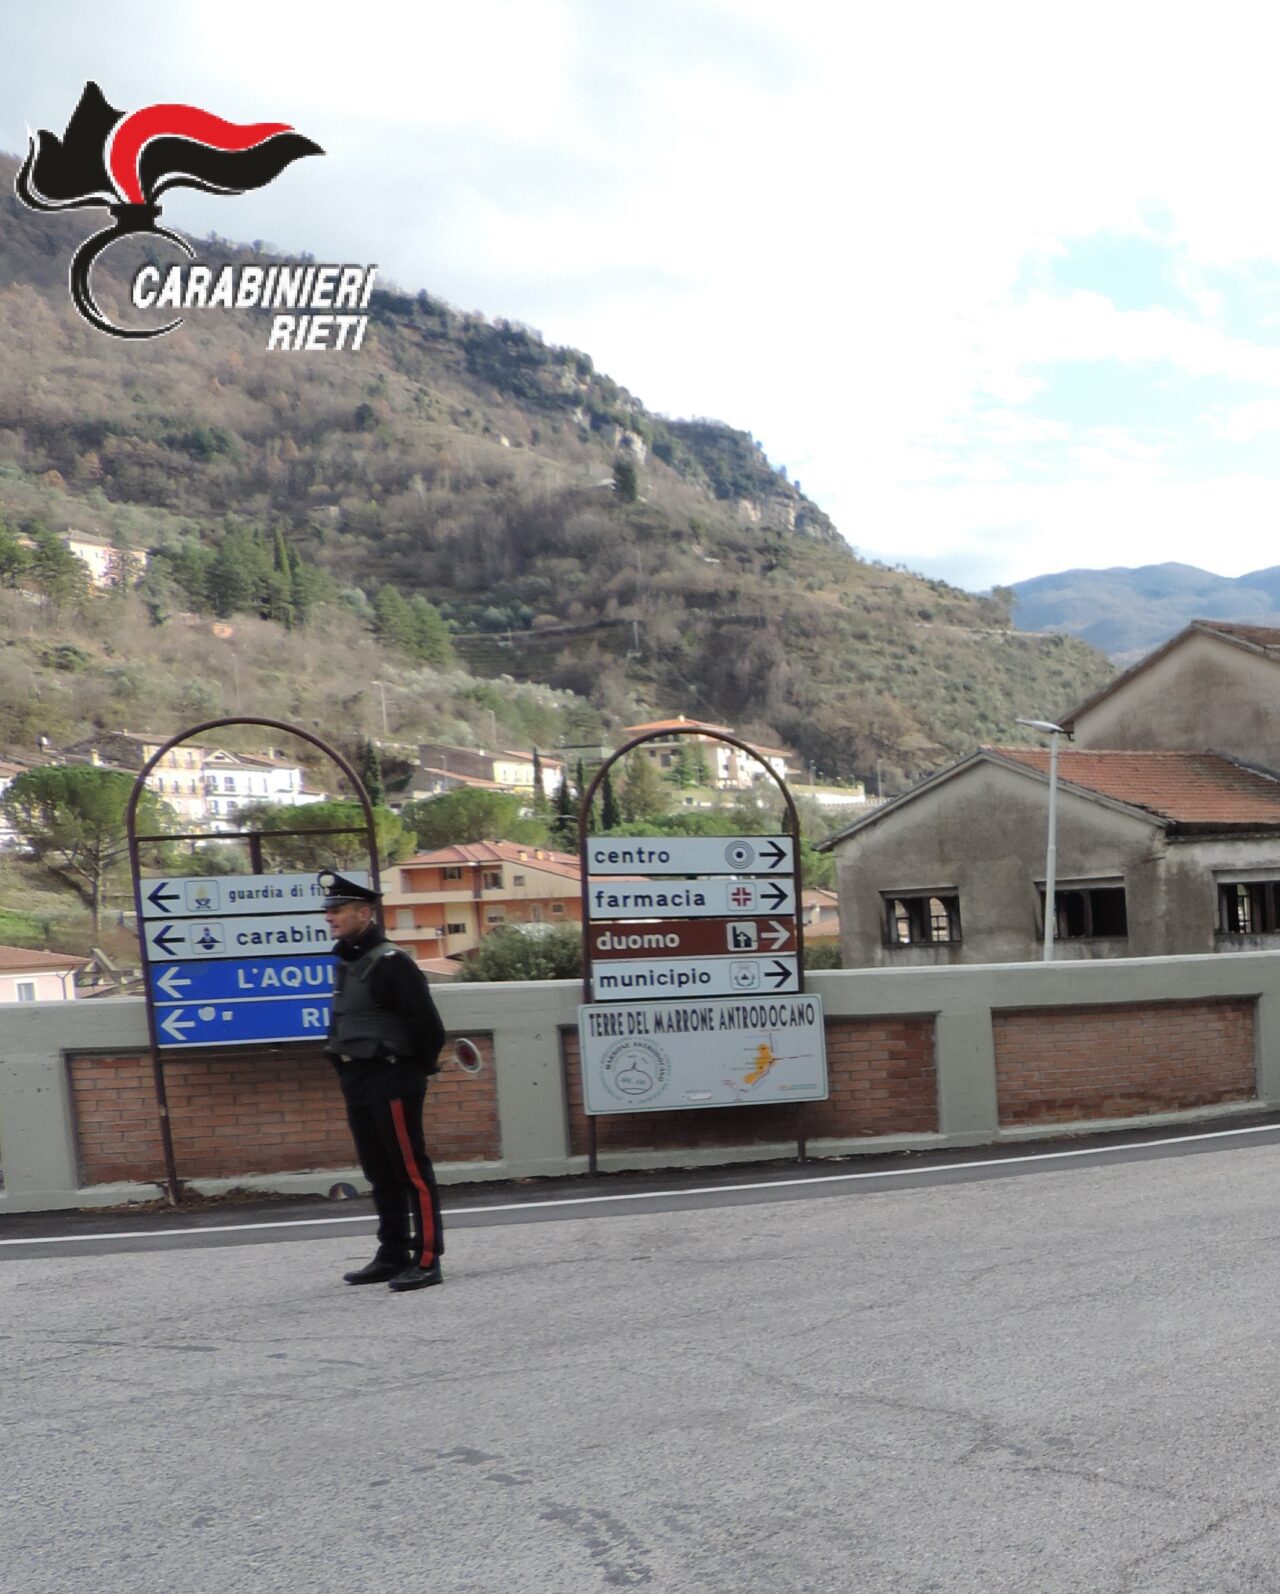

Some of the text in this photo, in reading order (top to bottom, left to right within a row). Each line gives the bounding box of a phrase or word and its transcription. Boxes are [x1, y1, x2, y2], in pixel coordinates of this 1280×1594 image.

[594, 848, 670, 865] centro
[228, 884, 284, 903] guardia
[290, 883, 304, 898] di
[595, 889, 706, 909] farmacia
[236, 925, 334, 946] carabin
[596, 931, 680, 951] duomo
[236, 964, 334, 989] L'AQUI
[599, 968, 711, 989] municipio
[302, 1007, 331, 1028] RI
[589, 1003, 815, 1037] TERRE DEL MARRONE ANTRODOCANO
